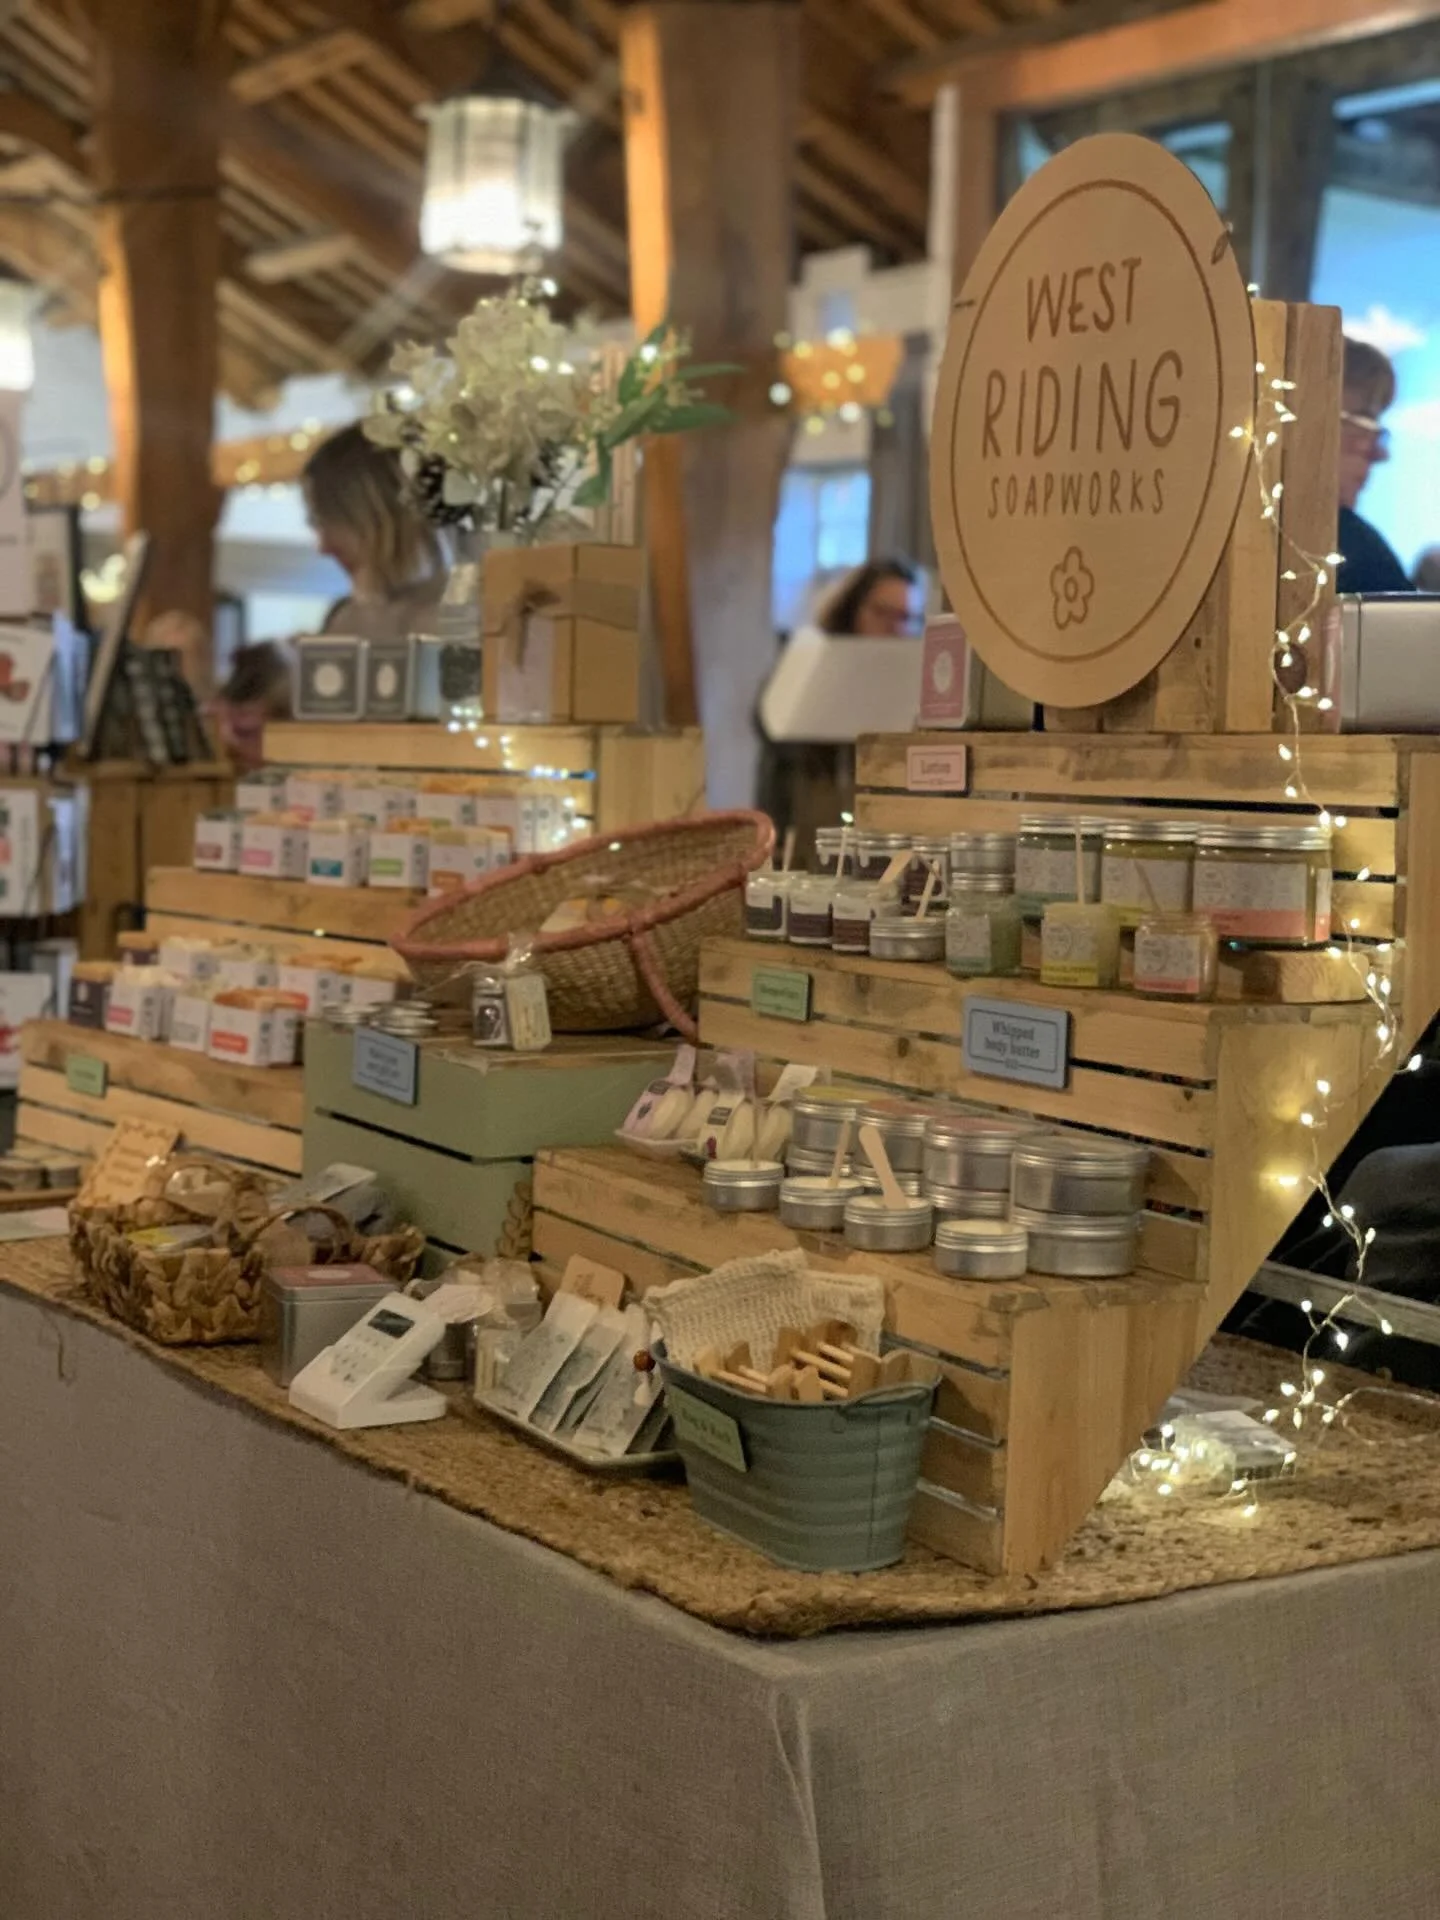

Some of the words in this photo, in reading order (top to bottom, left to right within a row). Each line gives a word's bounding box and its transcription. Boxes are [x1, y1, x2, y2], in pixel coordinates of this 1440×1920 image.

[1027, 257, 1141, 343] WEST
[982, 350, 1183, 458] RIDING
[988, 467, 1165, 519] SOAPWORKS
[985, 1037, 1007, 1056] body
[1010, 1041, 1040, 1058] butter
[993, 1021, 1035, 1040] Whipped
